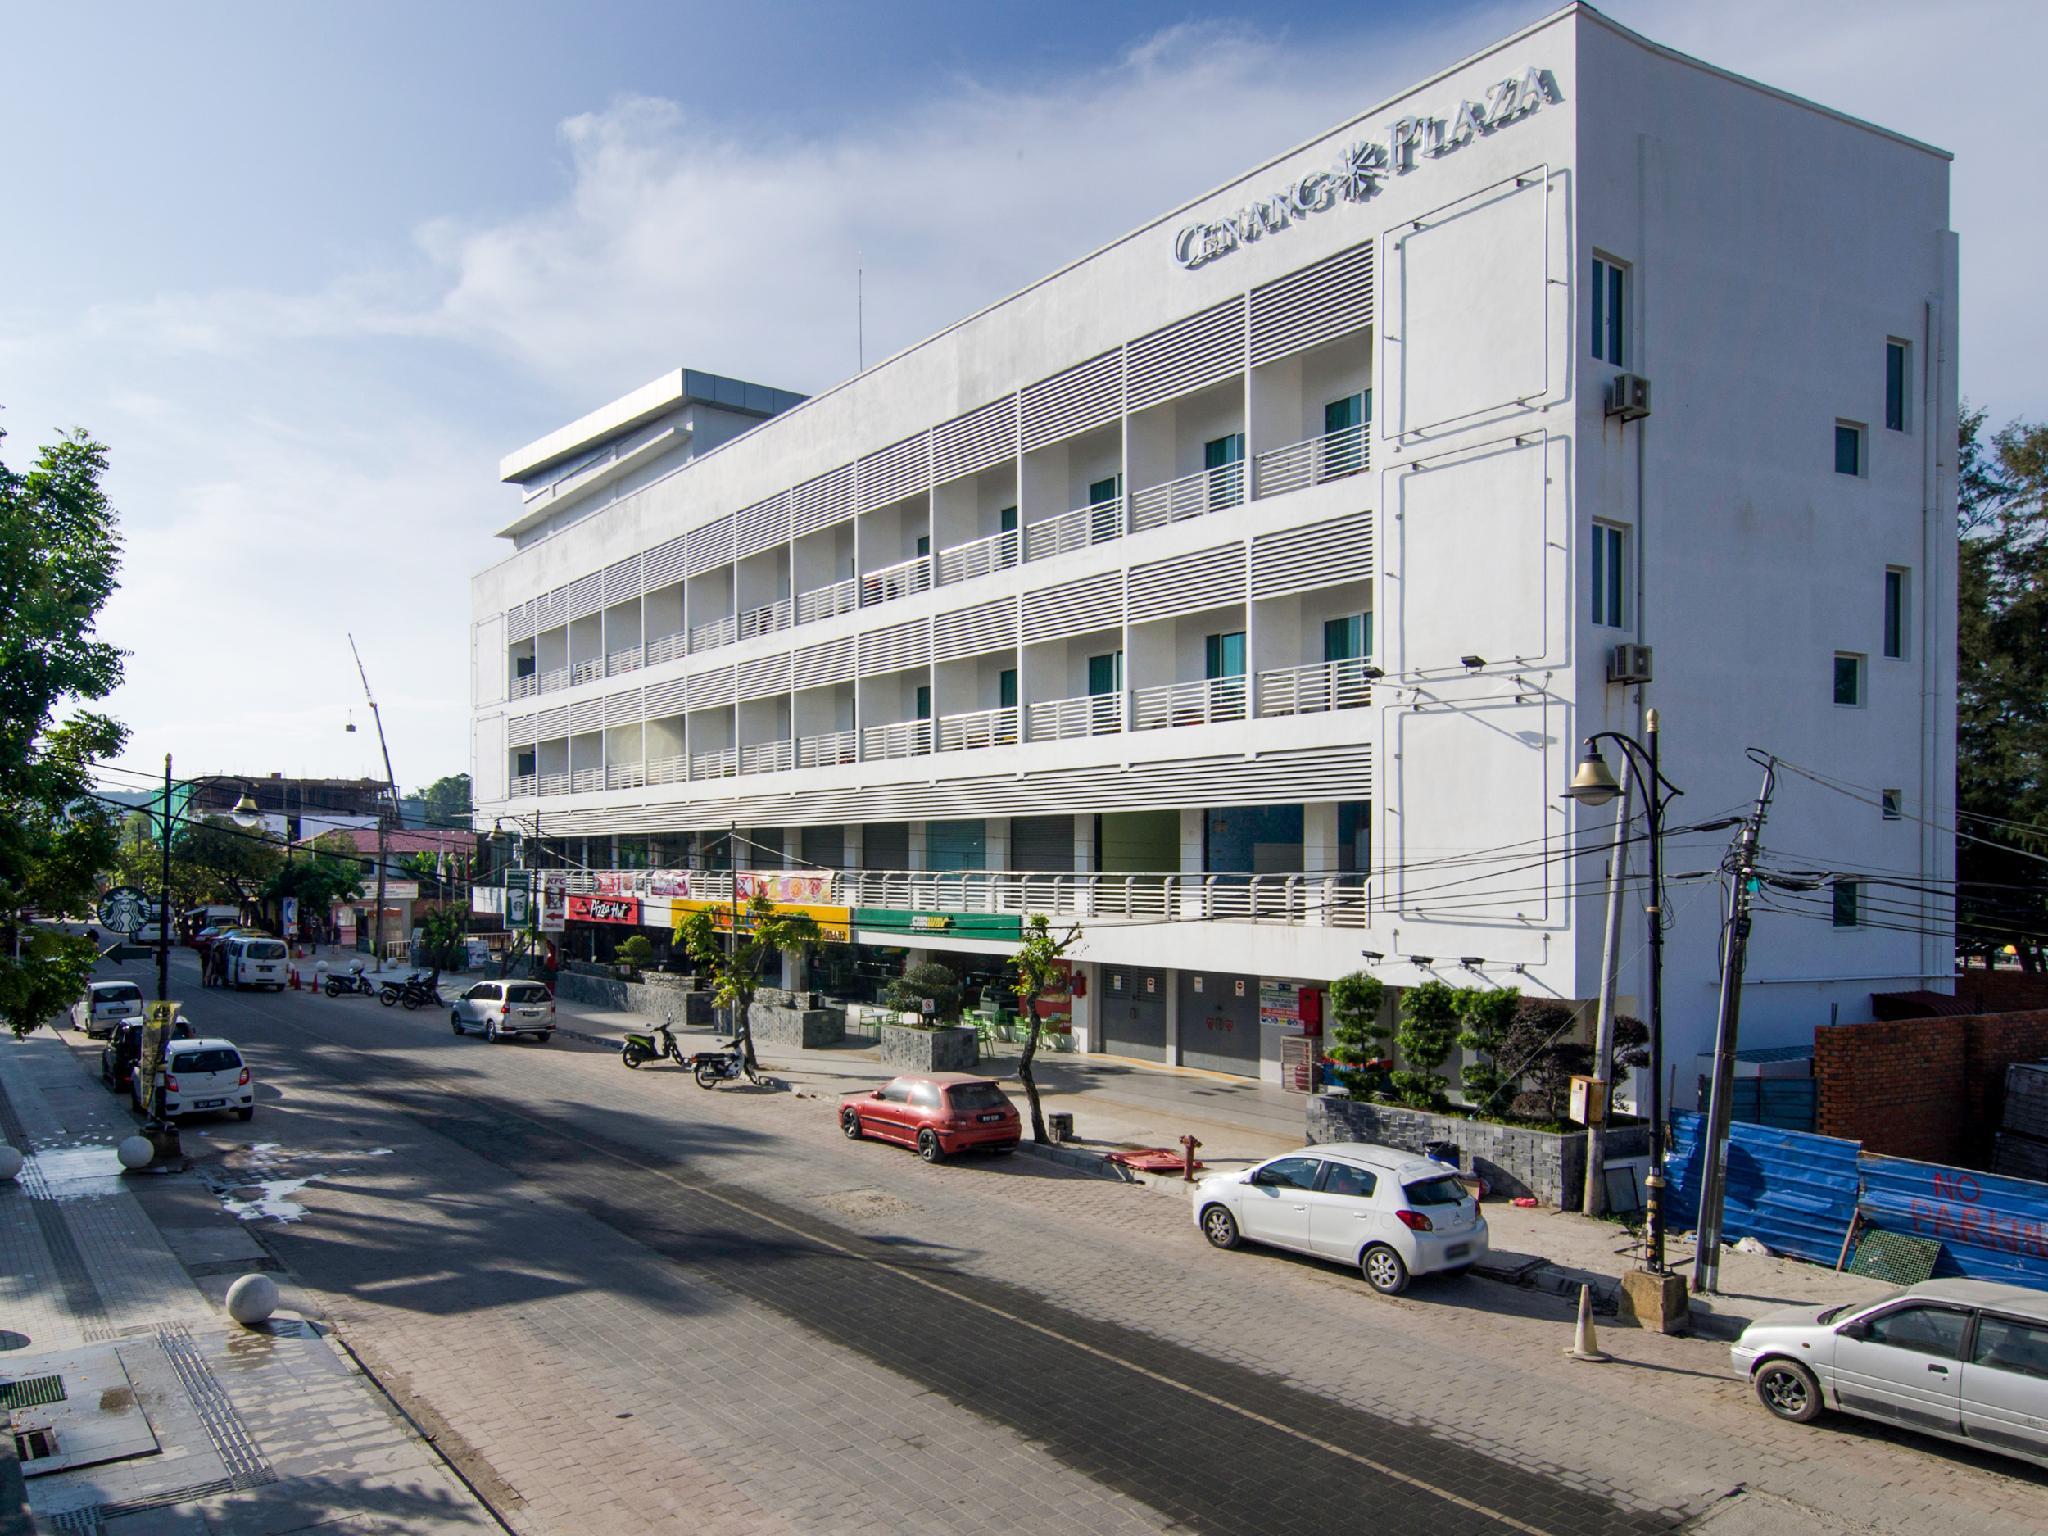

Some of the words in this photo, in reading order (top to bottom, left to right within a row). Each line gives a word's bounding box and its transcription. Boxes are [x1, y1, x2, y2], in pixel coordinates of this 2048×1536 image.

[1171, 168, 1334, 269] CENANG
[1385, 66, 1554, 175] PLAZA
[590, 899, 611, 919] Pizza
[611, 901, 628, 918] Hut
[1934, 1172, 1981, 1203] NO
